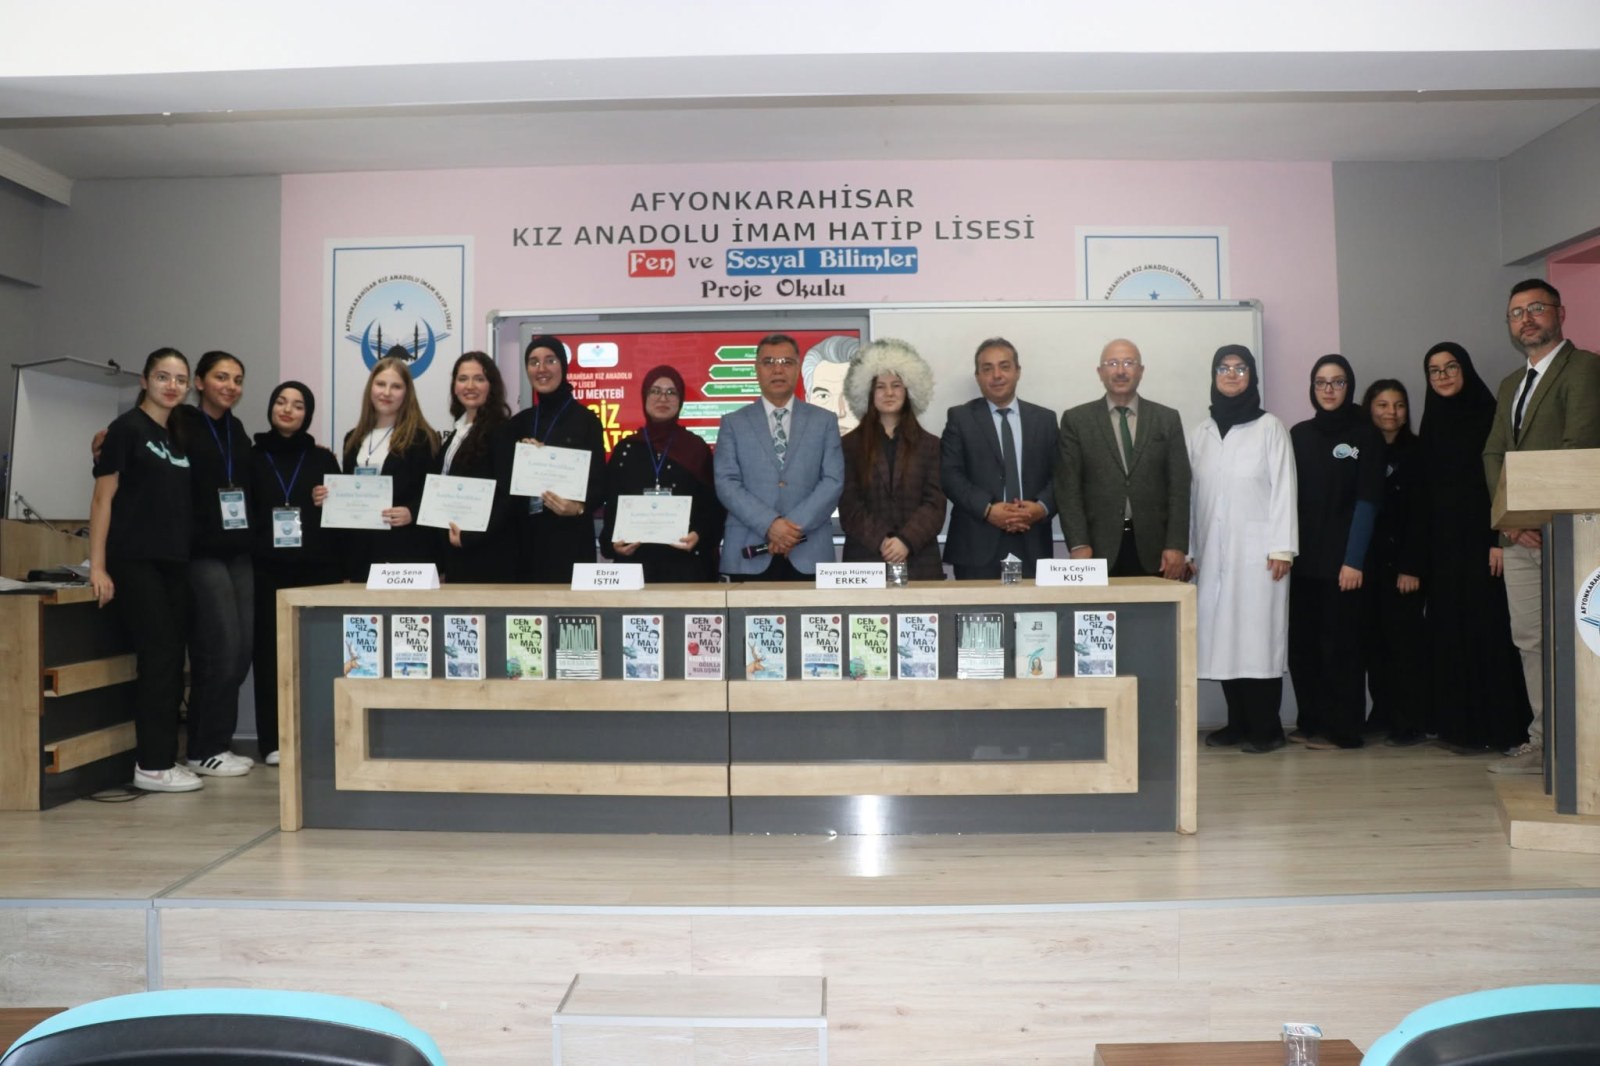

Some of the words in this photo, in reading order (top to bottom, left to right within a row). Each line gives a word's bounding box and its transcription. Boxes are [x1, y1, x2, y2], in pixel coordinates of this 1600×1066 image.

[630, 184, 914, 212] AFYONKARAHİSAR
[513, 227, 562, 246] KIZ
[574, 224, 719, 245] ANADOLU
[732, 218, 816, 242] İMAM
[829, 215, 922, 241] HATİP
[936, 214, 1035, 240] LİSESİ
[630, 252, 674, 275] Fen
[688, 256, 714, 269] ve
[727, 250, 805, 274] Sosyal
[820, 248, 917, 271] Bilimler
[1132, 265, 1142, 273] KIZ
[1144, 264, 1174, 273] ANADOLU
[701, 280, 762, 302] Proje
[776, 278, 846, 299] Okulu
[586, 386, 624, 399] MEKTEBİ
[1581, 574, 1600, 614] AFYONKARAH
